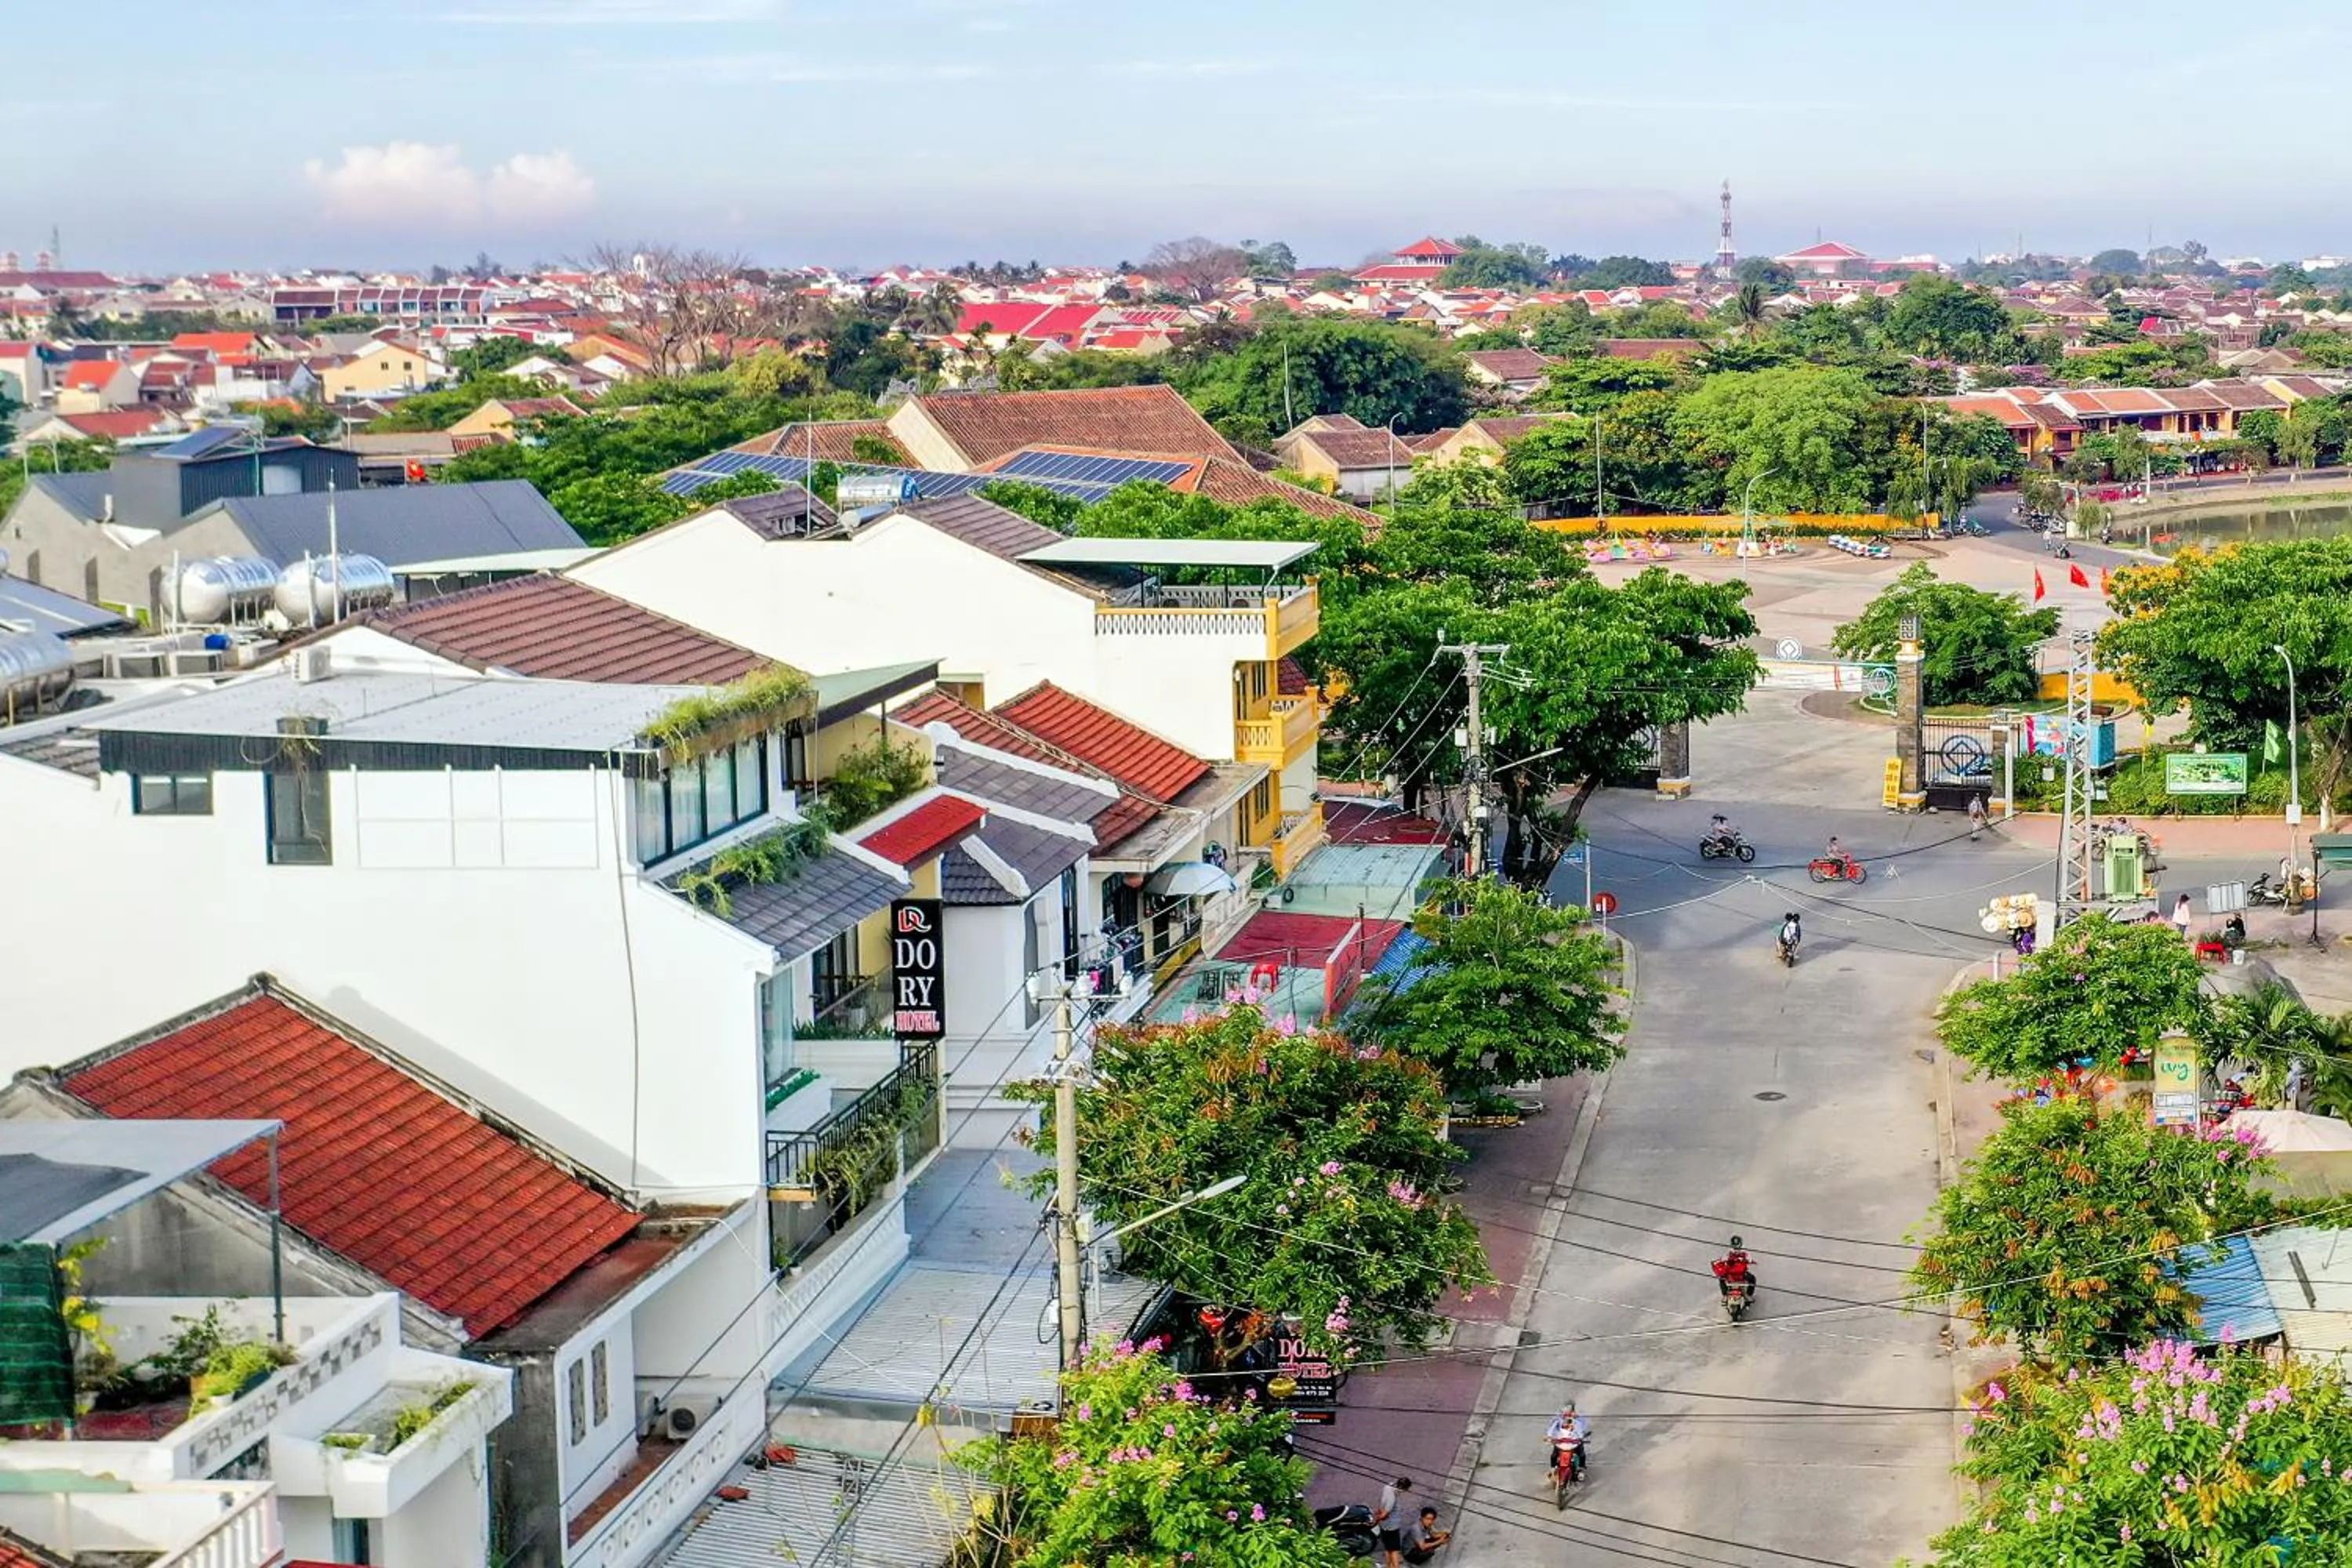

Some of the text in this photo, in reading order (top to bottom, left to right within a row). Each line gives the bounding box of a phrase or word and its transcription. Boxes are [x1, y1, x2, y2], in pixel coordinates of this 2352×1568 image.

[895, 938, 937, 970] DO
[898, 976, 935, 1007] RY
[895, 1011, 941, 1033] HOTEL
